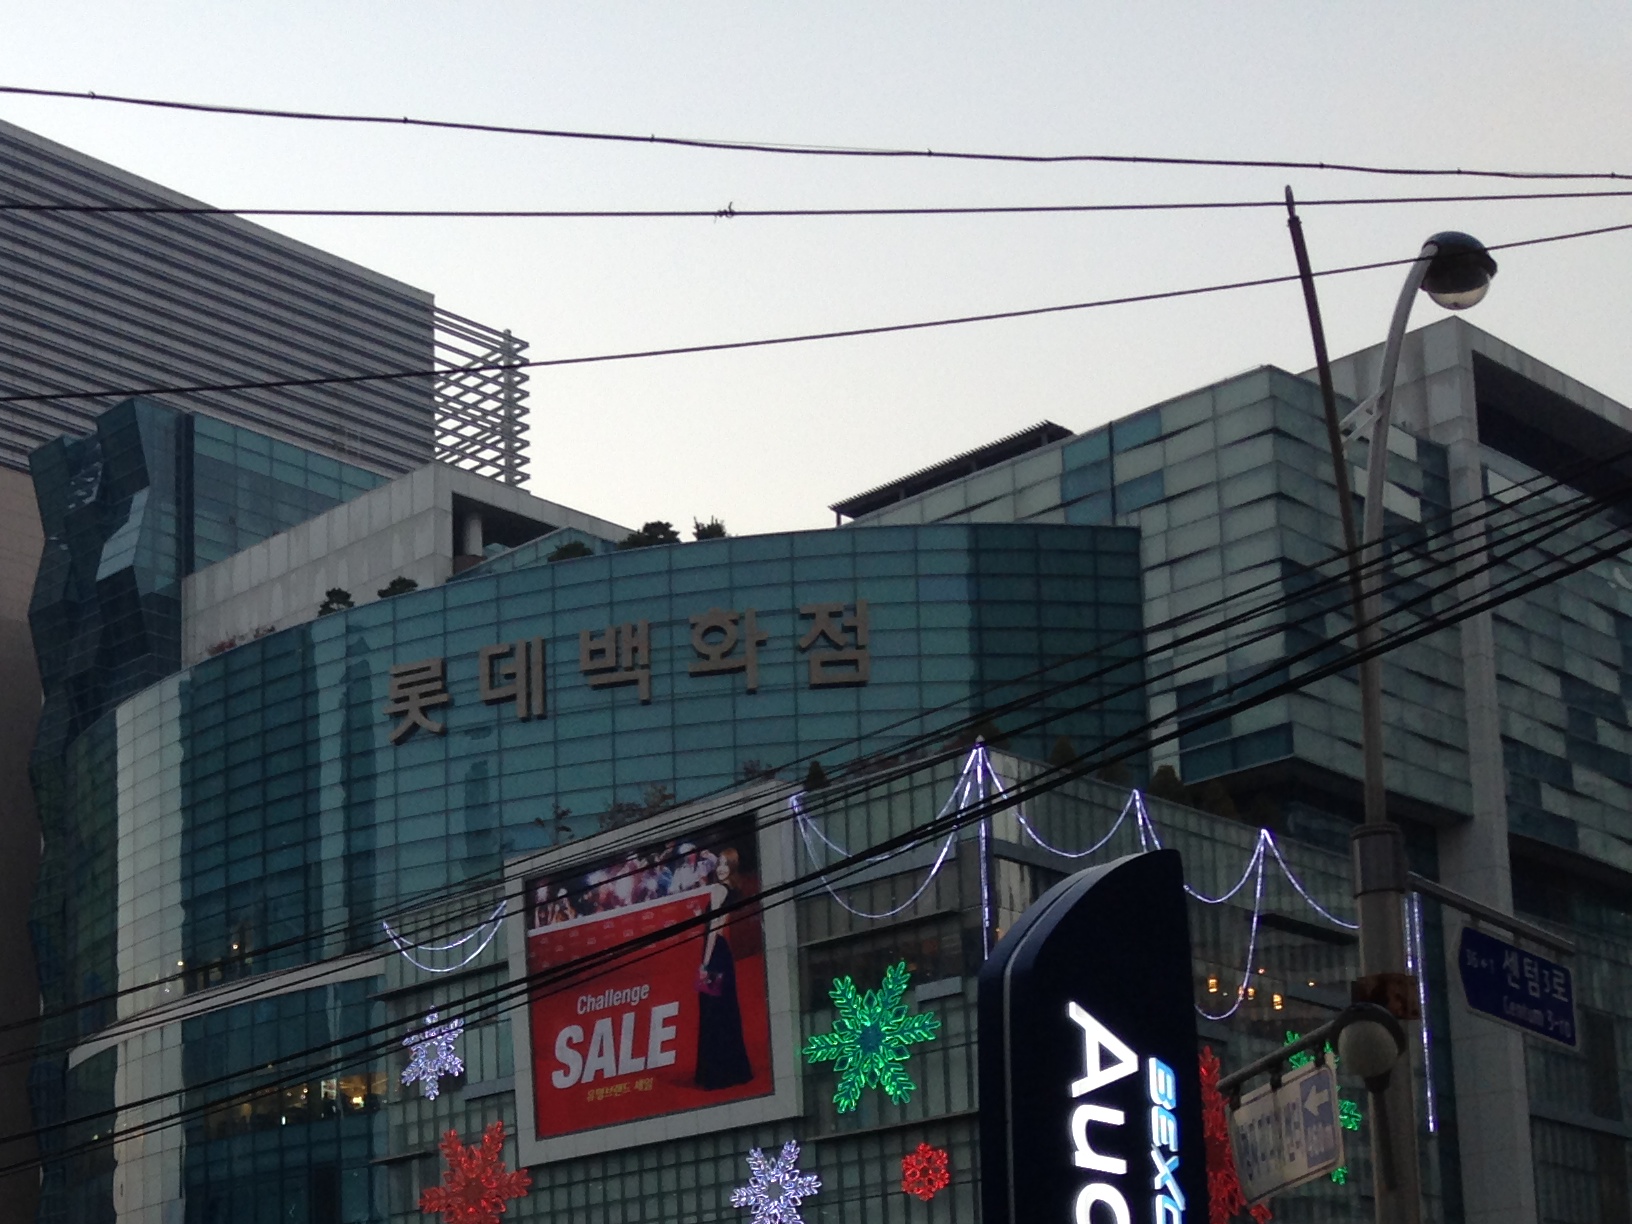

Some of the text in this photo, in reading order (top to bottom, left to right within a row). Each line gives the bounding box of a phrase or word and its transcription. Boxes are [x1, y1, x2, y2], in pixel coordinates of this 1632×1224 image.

[384, 600, 868, 745] 롯데백화점
[577, 984, 650, 1016] Challenge
[551, 1001, 679, 1090] SALE
